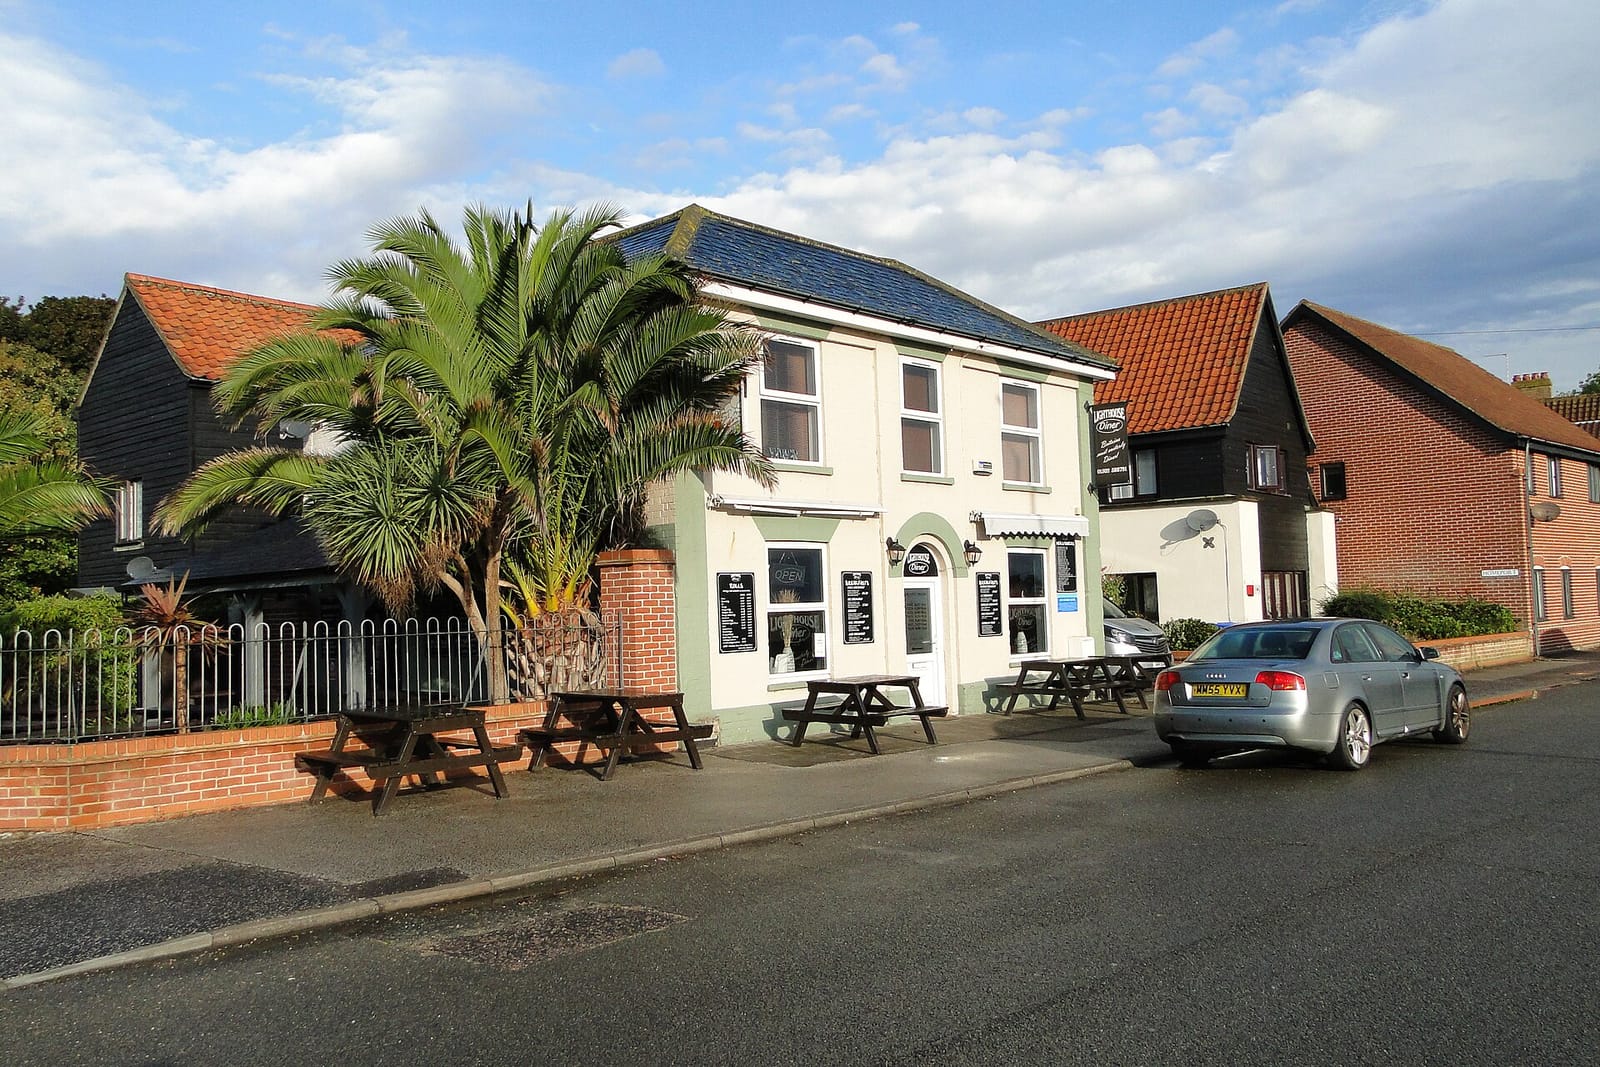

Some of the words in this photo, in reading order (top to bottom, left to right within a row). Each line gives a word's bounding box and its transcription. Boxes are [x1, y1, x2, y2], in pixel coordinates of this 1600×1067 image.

[1093, 408, 1126, 424] LIGHTHOUSE
[1099, 421, 1120, 430] Diner
[775, 570, 803, 582] OPEN
